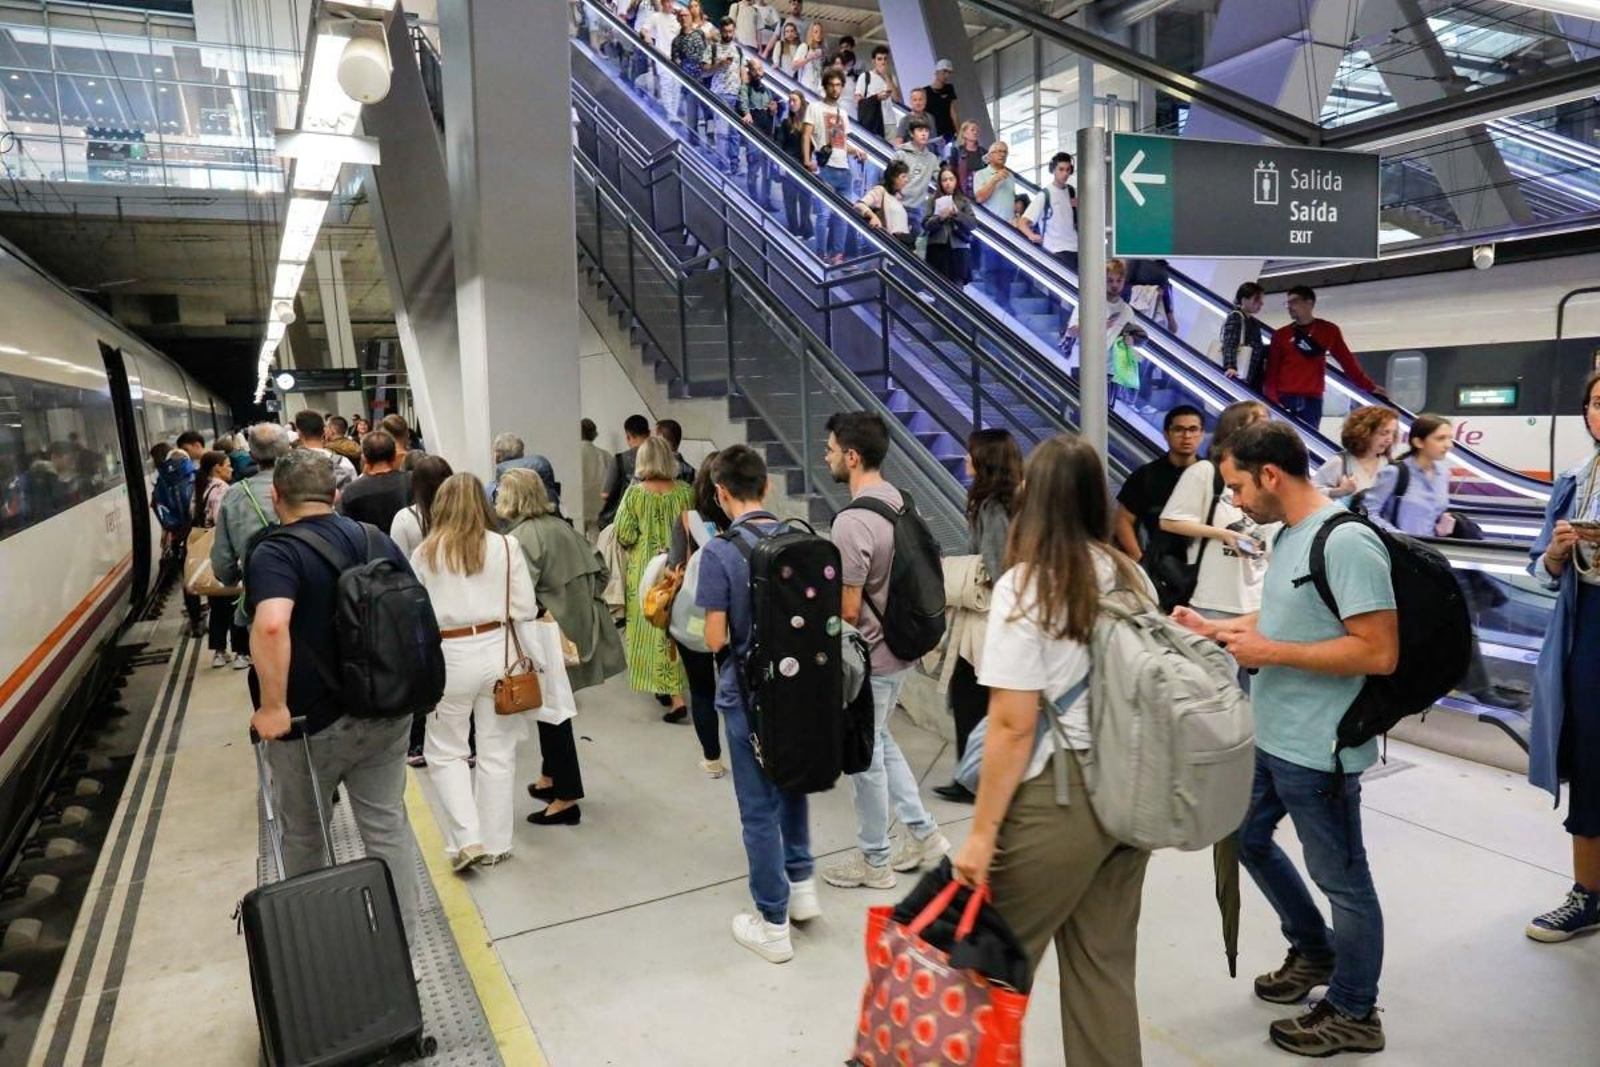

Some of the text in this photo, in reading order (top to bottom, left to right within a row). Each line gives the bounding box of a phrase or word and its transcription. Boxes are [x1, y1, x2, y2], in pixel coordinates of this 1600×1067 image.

[1291, 168, 1342, 191] Salida
[1290, 200, 1337, 222] Saída
[1290, 230, 1313, 244] EXIT
